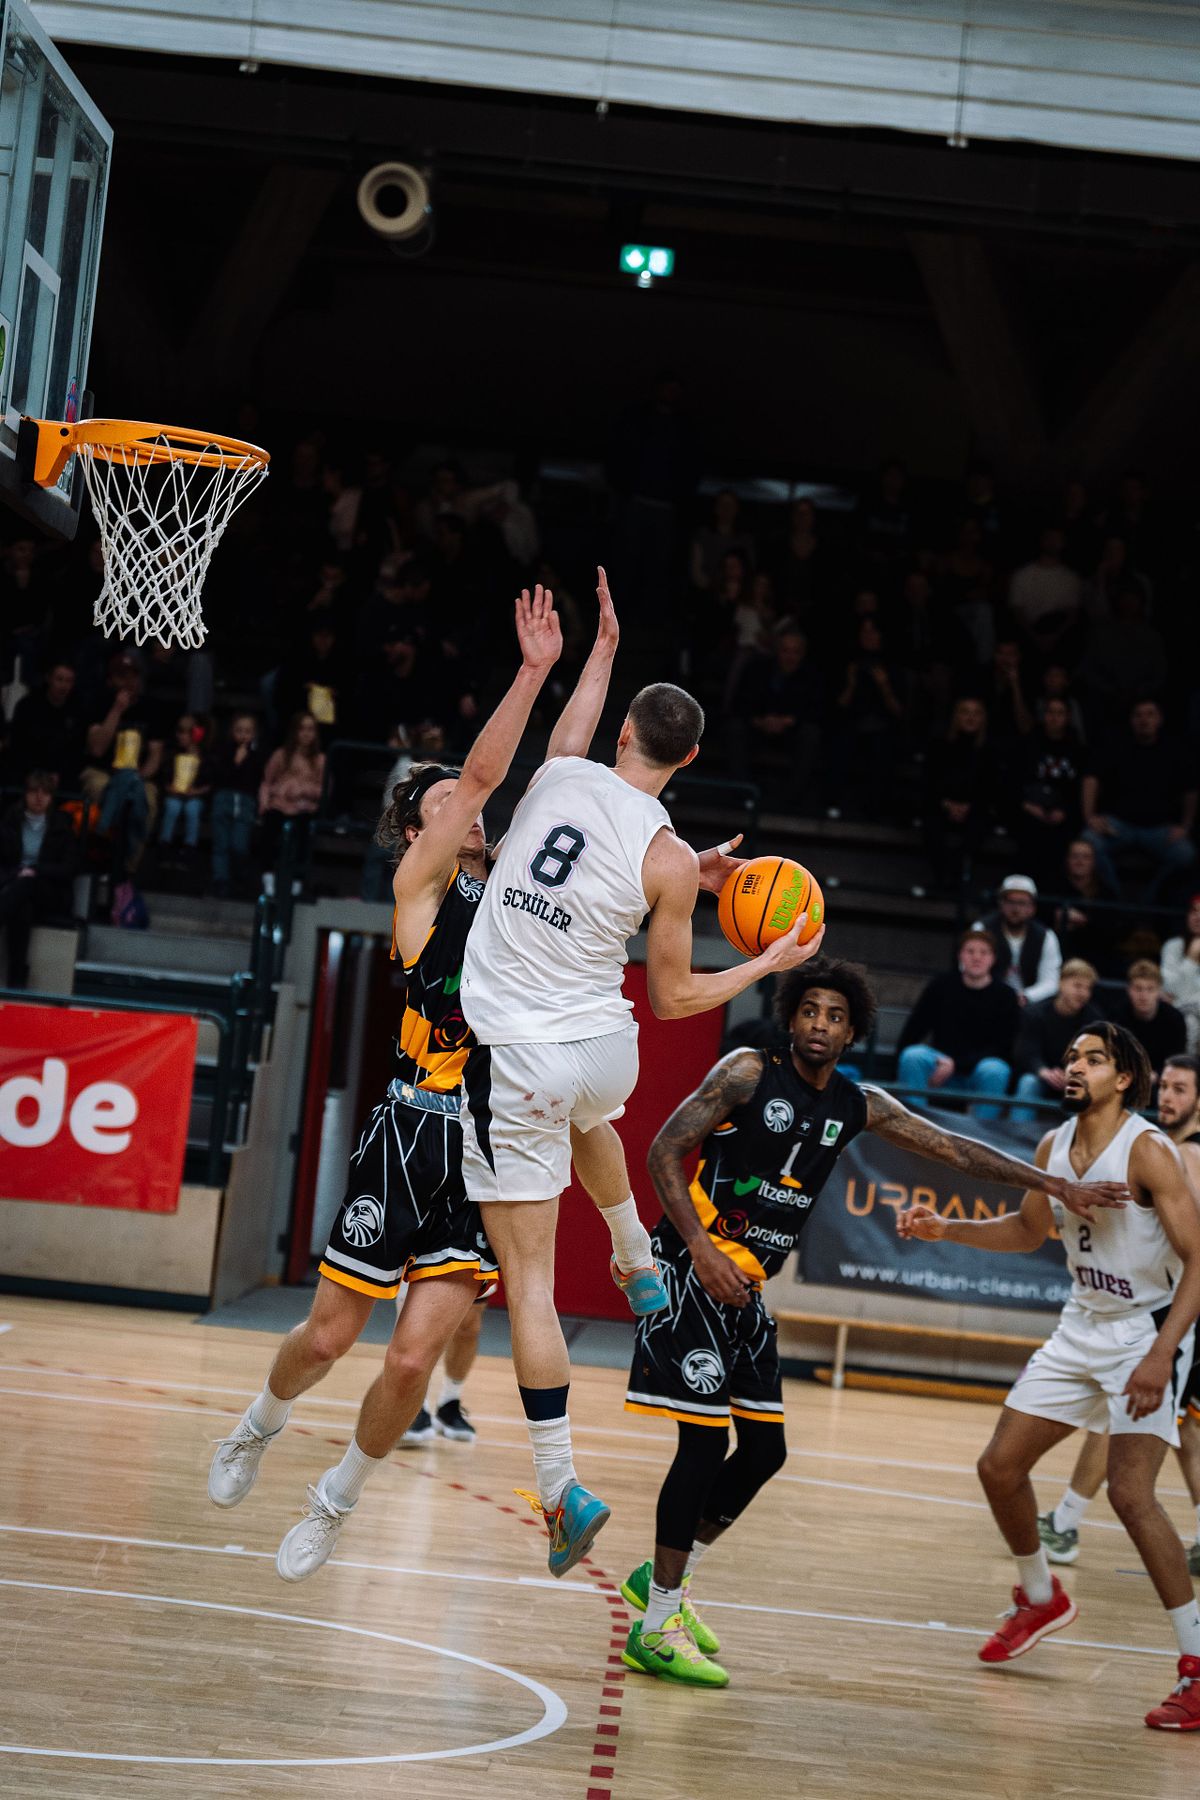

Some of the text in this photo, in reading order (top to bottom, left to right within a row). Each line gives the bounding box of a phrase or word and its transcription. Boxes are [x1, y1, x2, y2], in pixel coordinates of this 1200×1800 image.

[528, 821, 588, 889] 8
[742, 874, 756, 894] FIBA
[768, 869, 805, 930] Wilson
[503, 887, 572, 933] SCHÜLER
[780, 1141, 803, 1177] 1
[1078, 1225, 1092, 1252] 2
